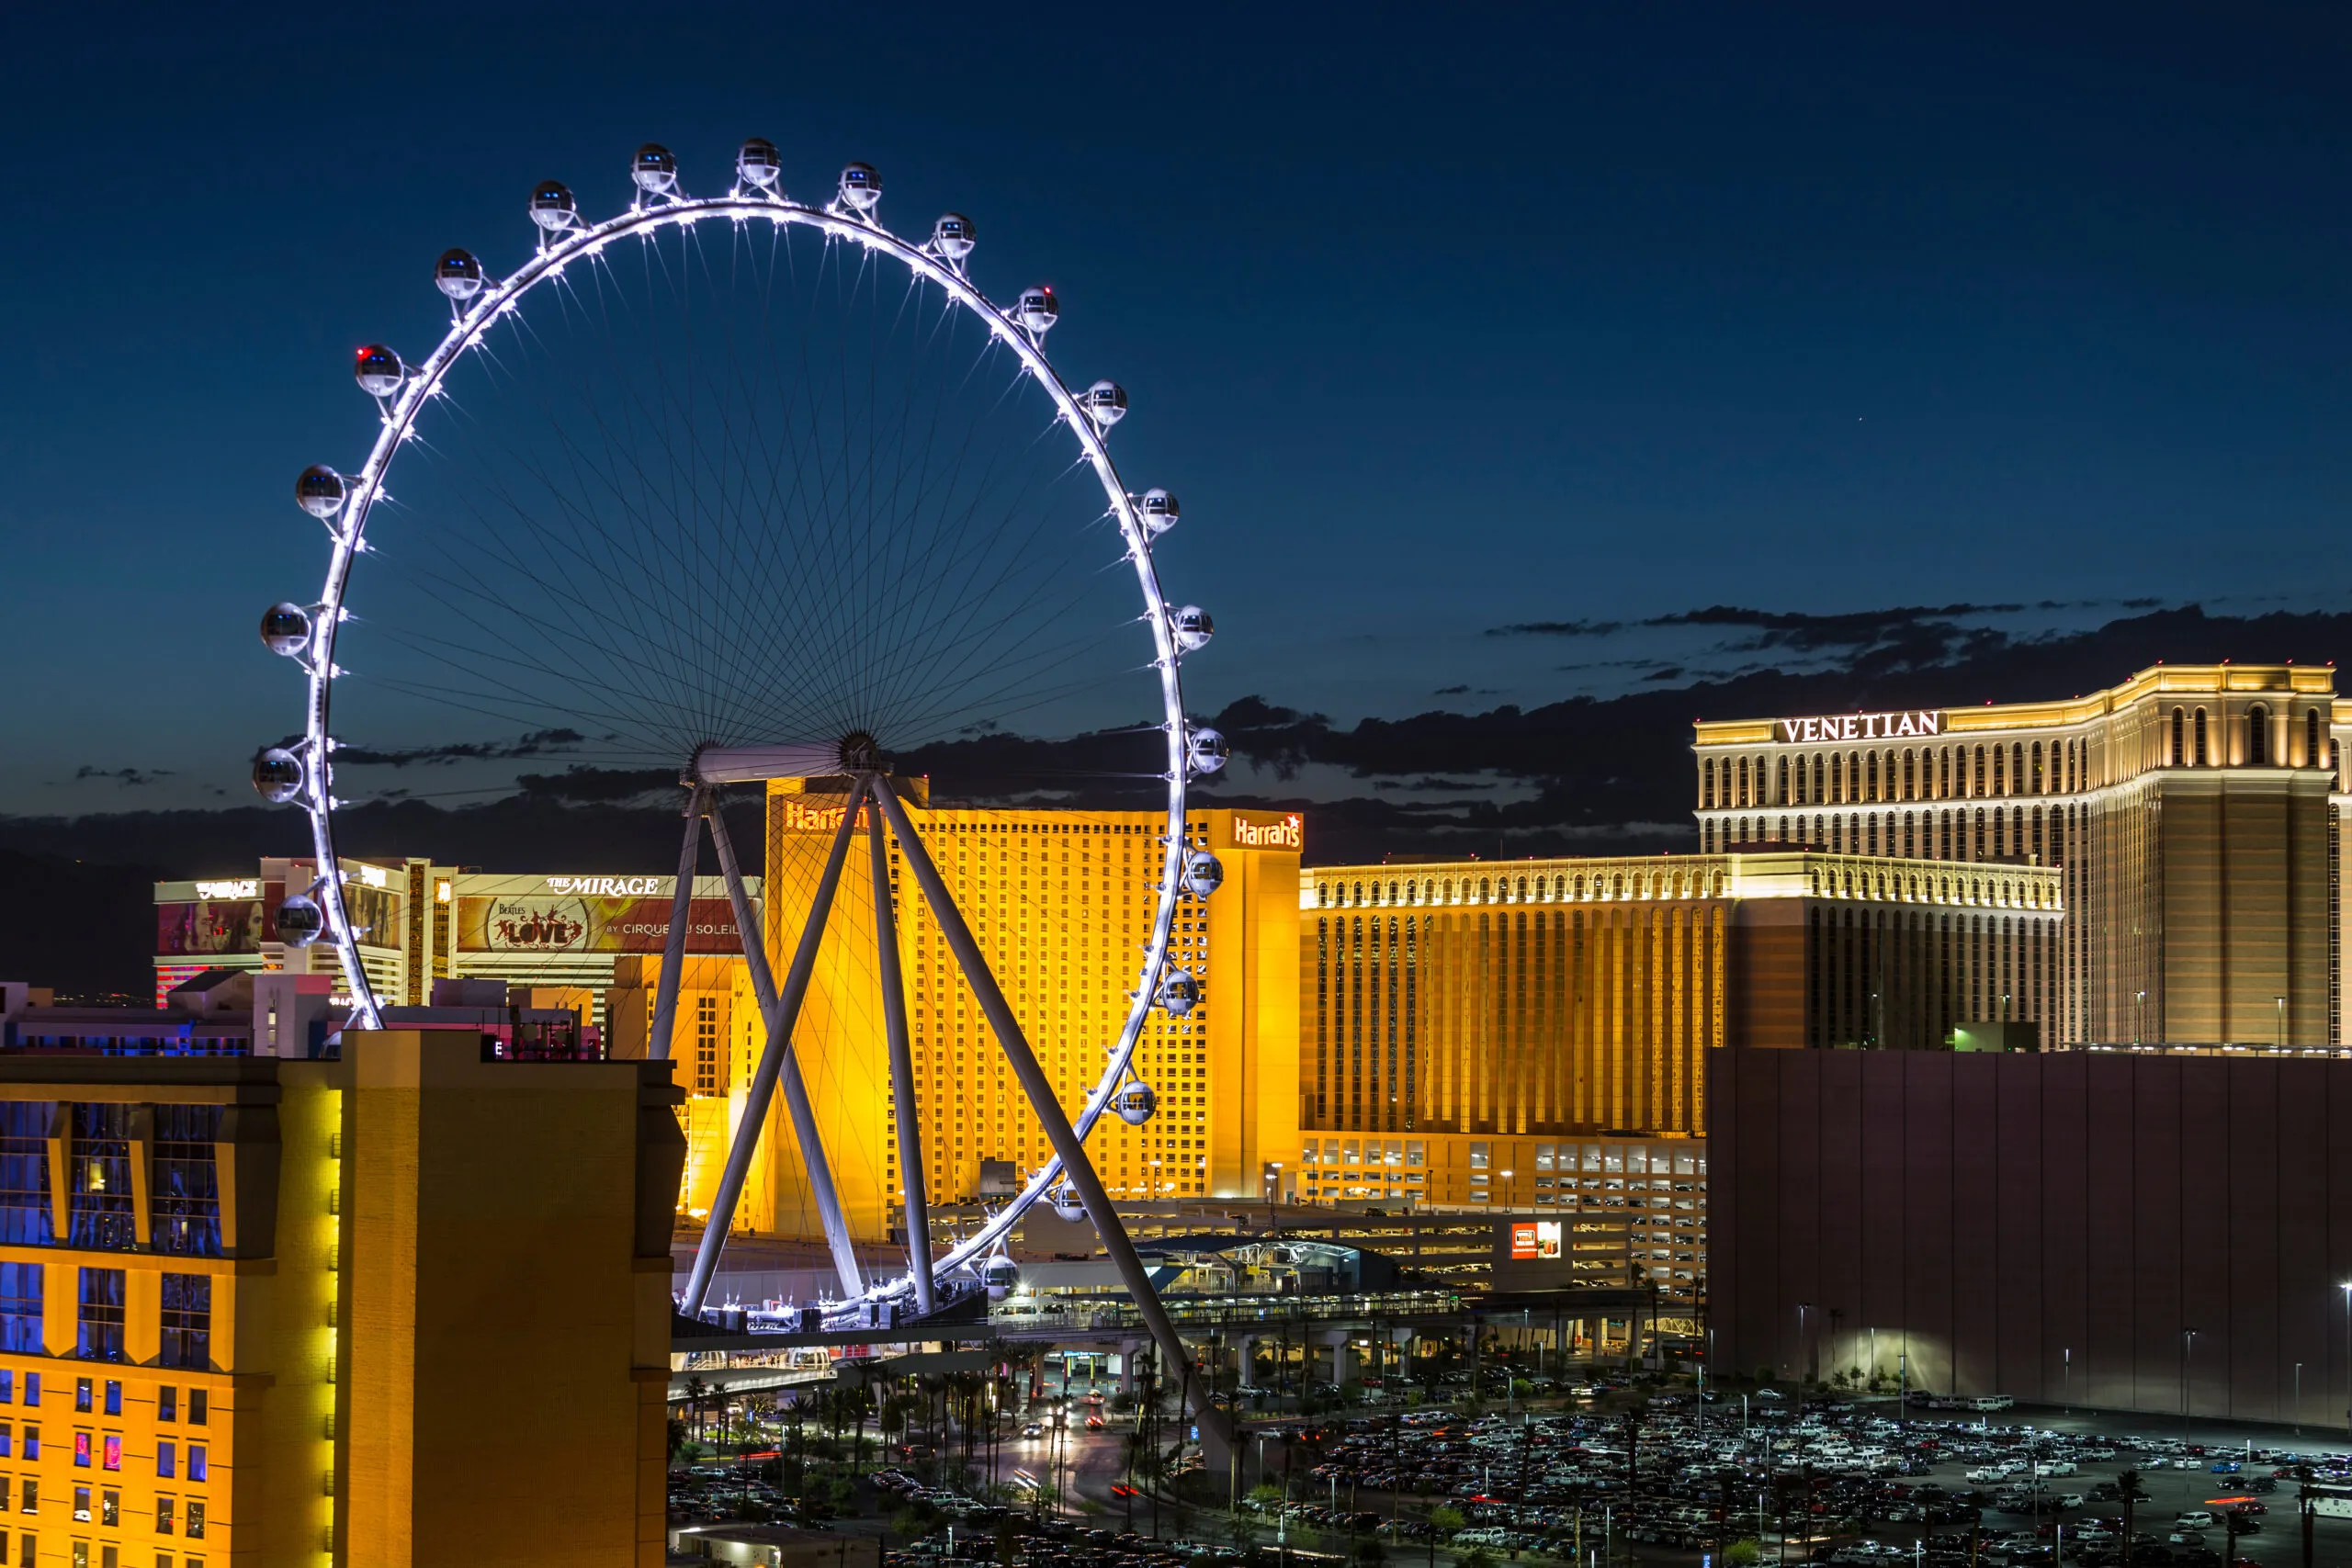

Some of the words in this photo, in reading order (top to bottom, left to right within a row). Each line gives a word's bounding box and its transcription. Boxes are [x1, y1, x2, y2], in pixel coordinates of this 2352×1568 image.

[1781, 711, 1940, 743] VENETIAN
[786, 801, 870, 830] Harrh
[547, 877, 571, 887] THE
[554, 877, 659, 897] MIRAGE
[508, 922, 569, 944] LOVE
[622, 923, 670, 937] CIRQUE
[695, 924, 739, 935] SOLEIL
